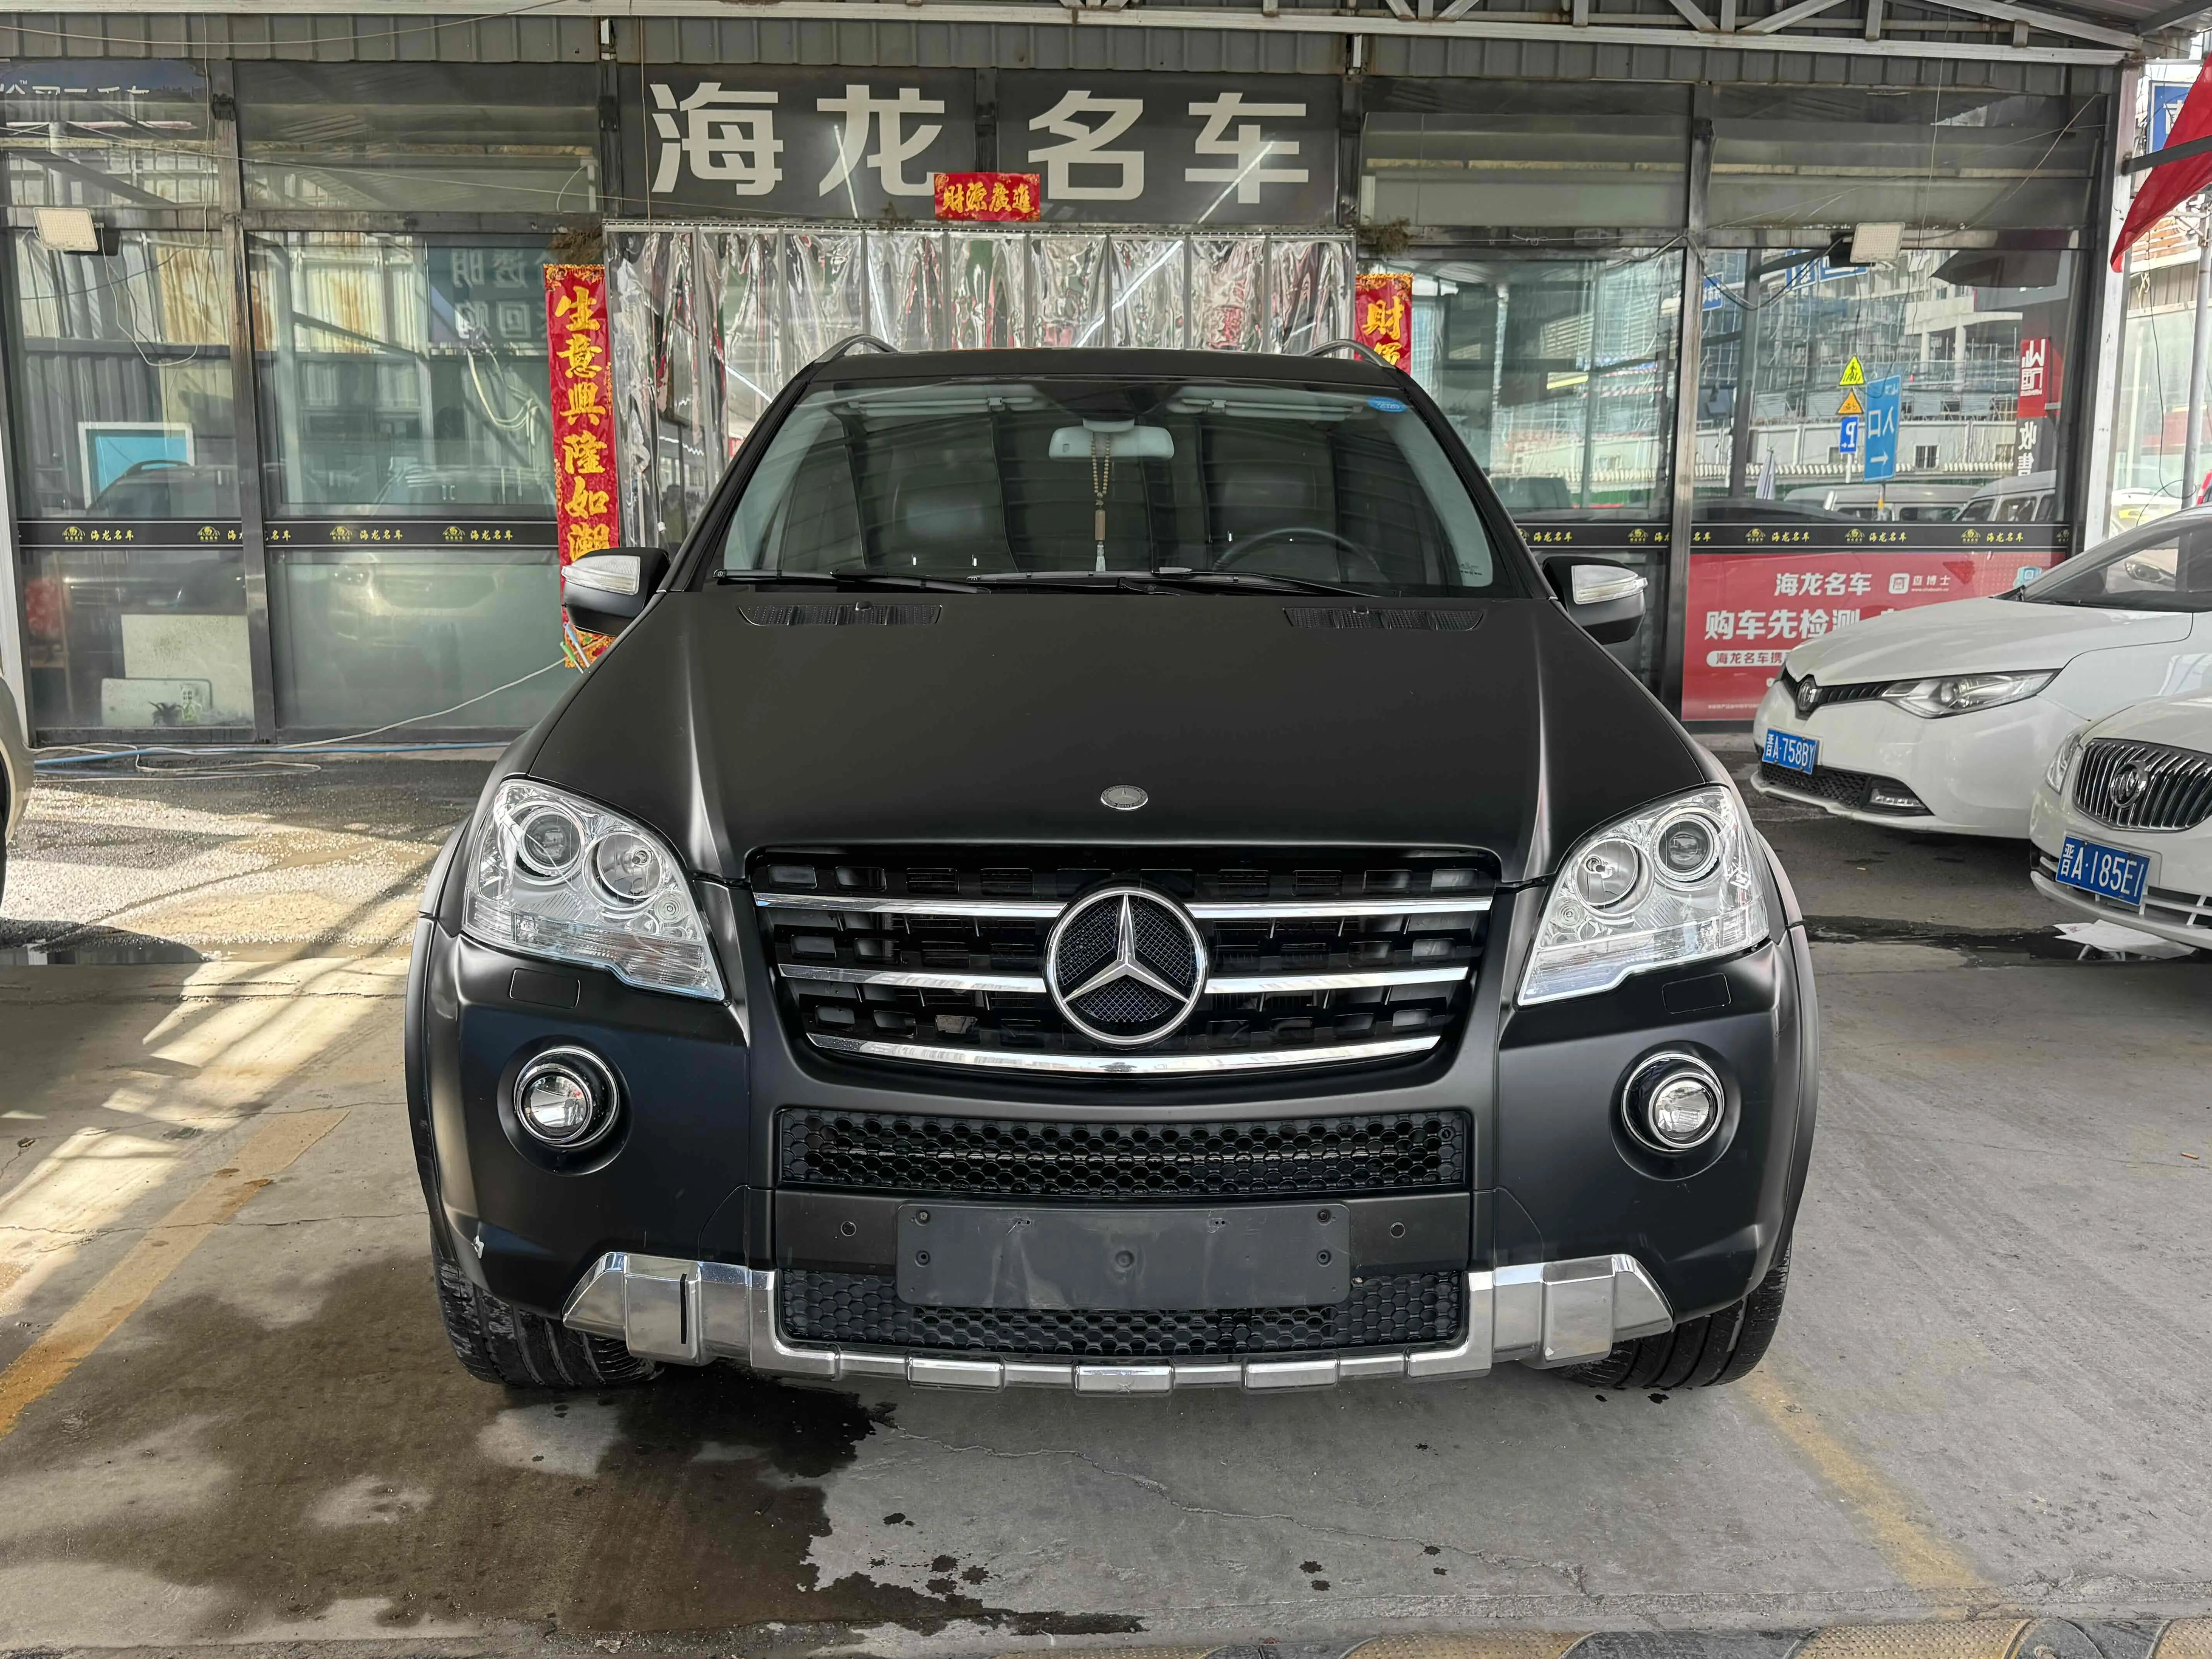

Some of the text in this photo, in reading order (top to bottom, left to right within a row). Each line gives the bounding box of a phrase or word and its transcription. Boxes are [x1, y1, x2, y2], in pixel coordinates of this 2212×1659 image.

[649, 82, 1309, 204] 海龙名车
[1774, 572, 1872, 596] 海龙名车
[1704, 609, 1860, 640] 购车先检测
[1716, 652, 1788, 664] 海龙名车携
